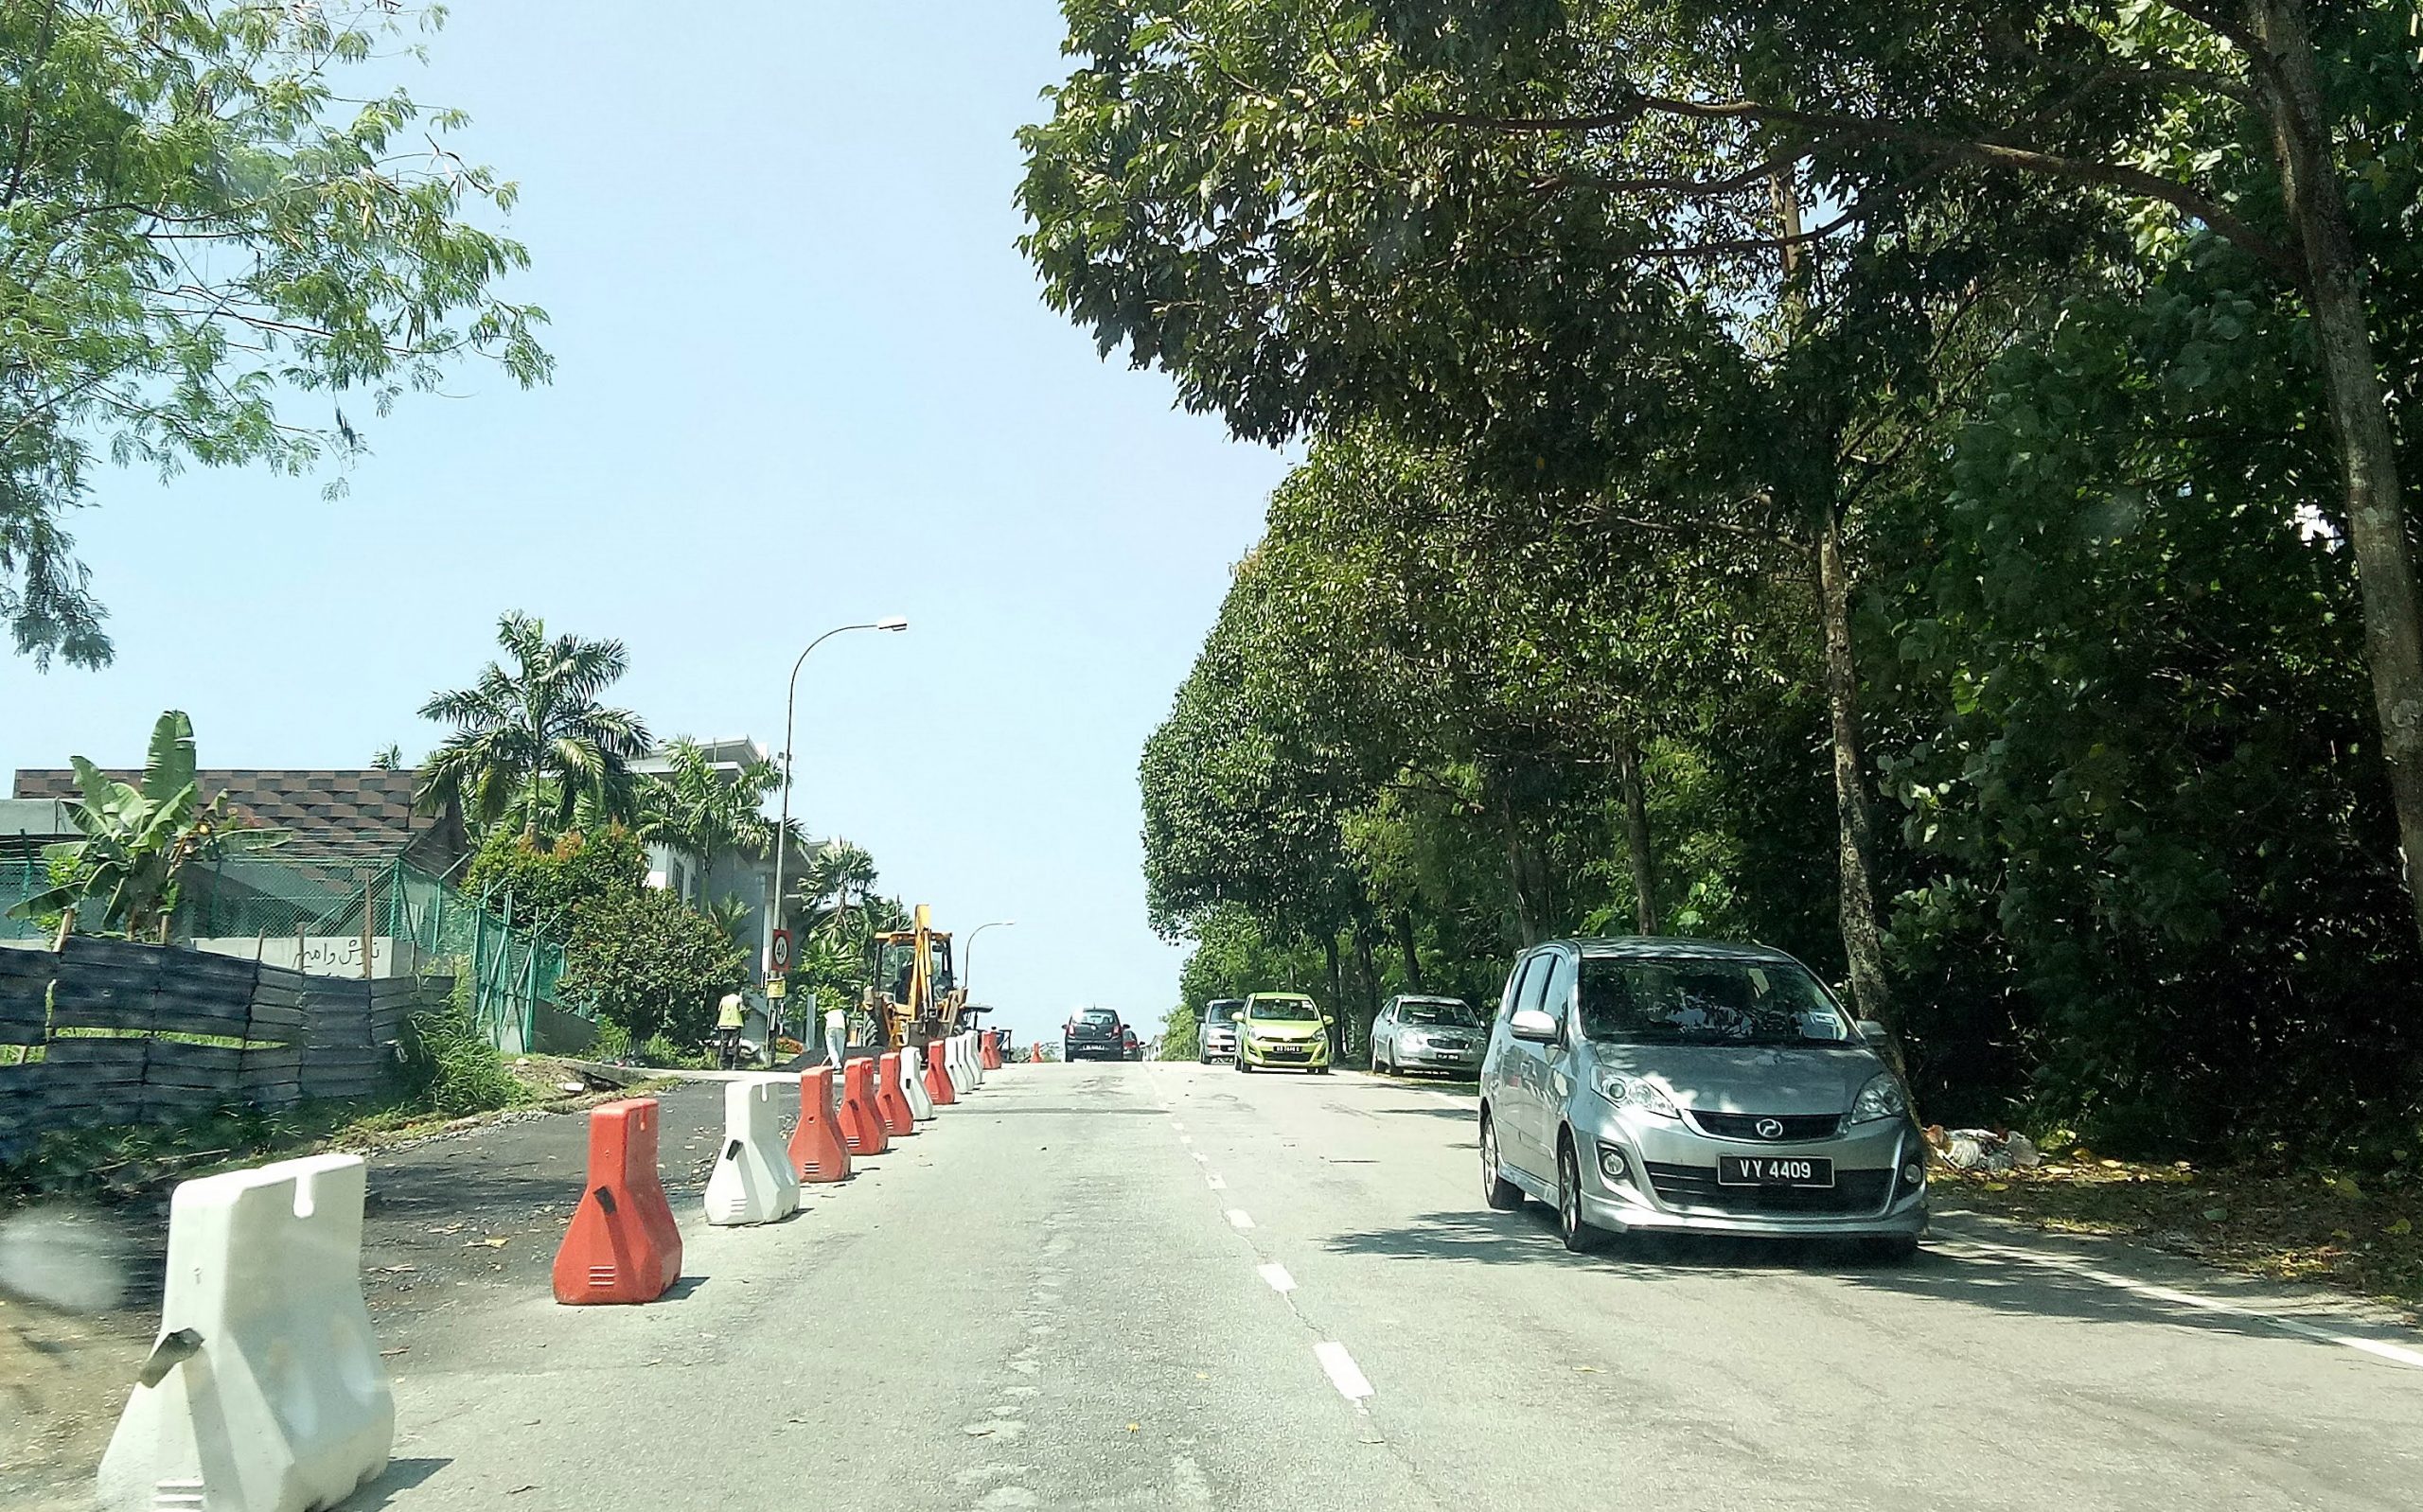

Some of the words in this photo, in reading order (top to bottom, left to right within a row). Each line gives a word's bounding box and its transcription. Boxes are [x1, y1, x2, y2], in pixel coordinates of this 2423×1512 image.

[776, 943, 786, 958] 40
[1740, 1159, 1761, 1178] VY
[1769, 1160, 1812, 1179] 4409
